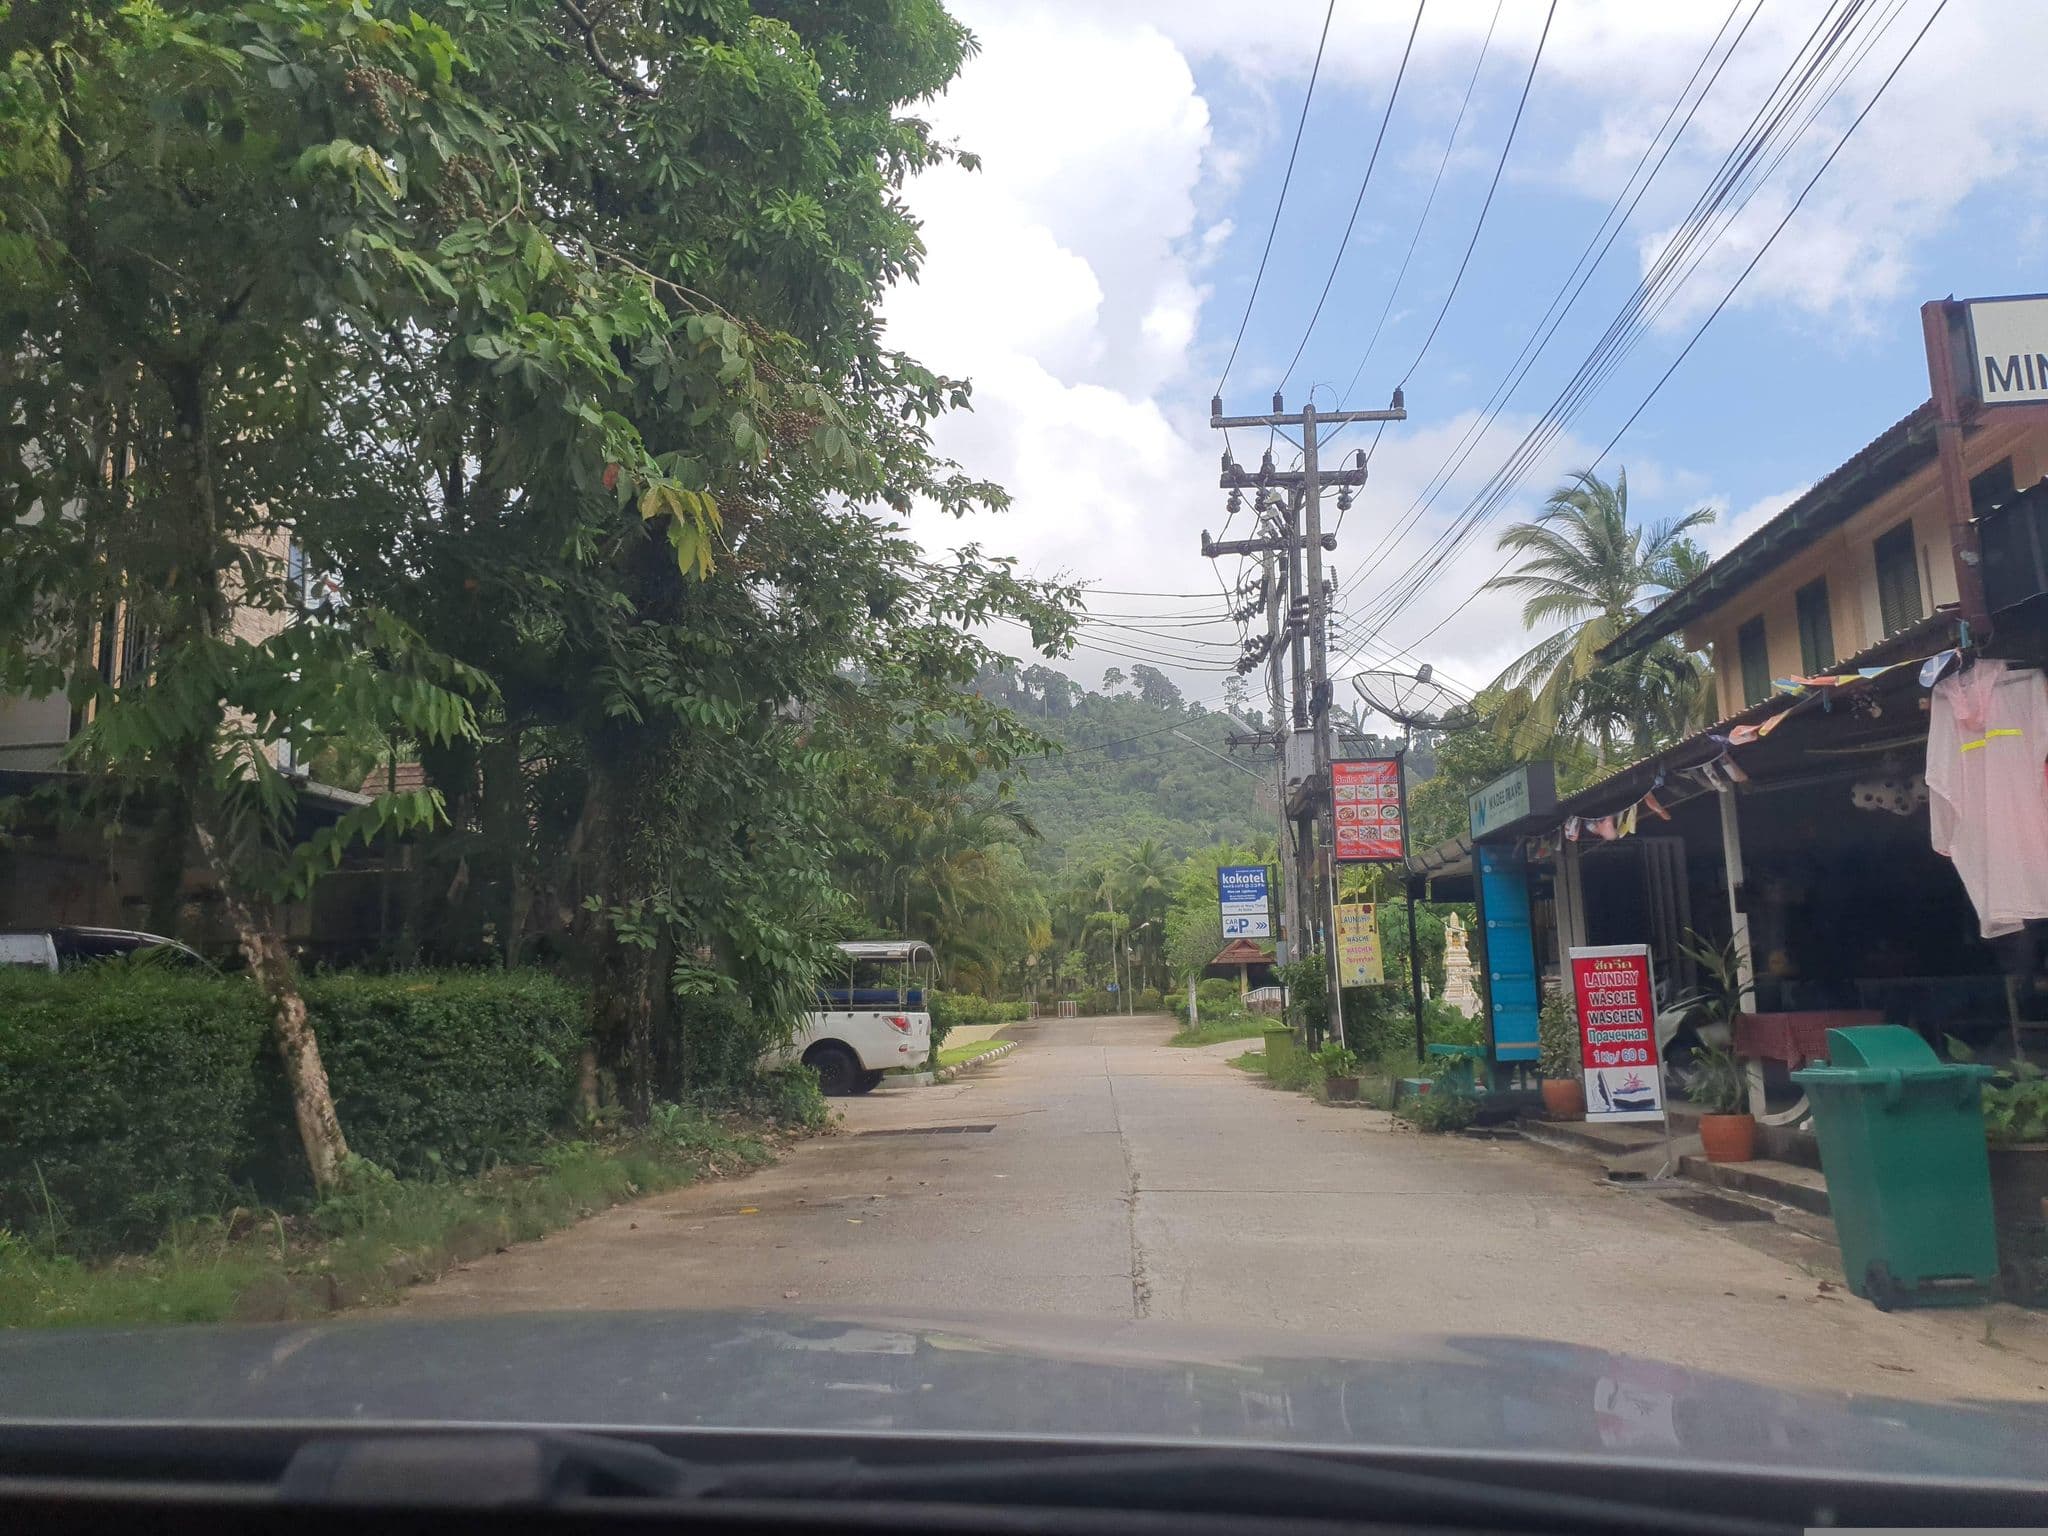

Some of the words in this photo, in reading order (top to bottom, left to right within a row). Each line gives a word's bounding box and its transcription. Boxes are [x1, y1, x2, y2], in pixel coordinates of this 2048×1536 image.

[1239, 918, 1249, 933] P
[1584, 970, 1639, 987] LAUNDRY
[1587, 1008, 1643, 1025] WASCHEN
[1587, 1028, 1648, 1046] Прачечная
[1593, 1050, 1600, 1063] 1
